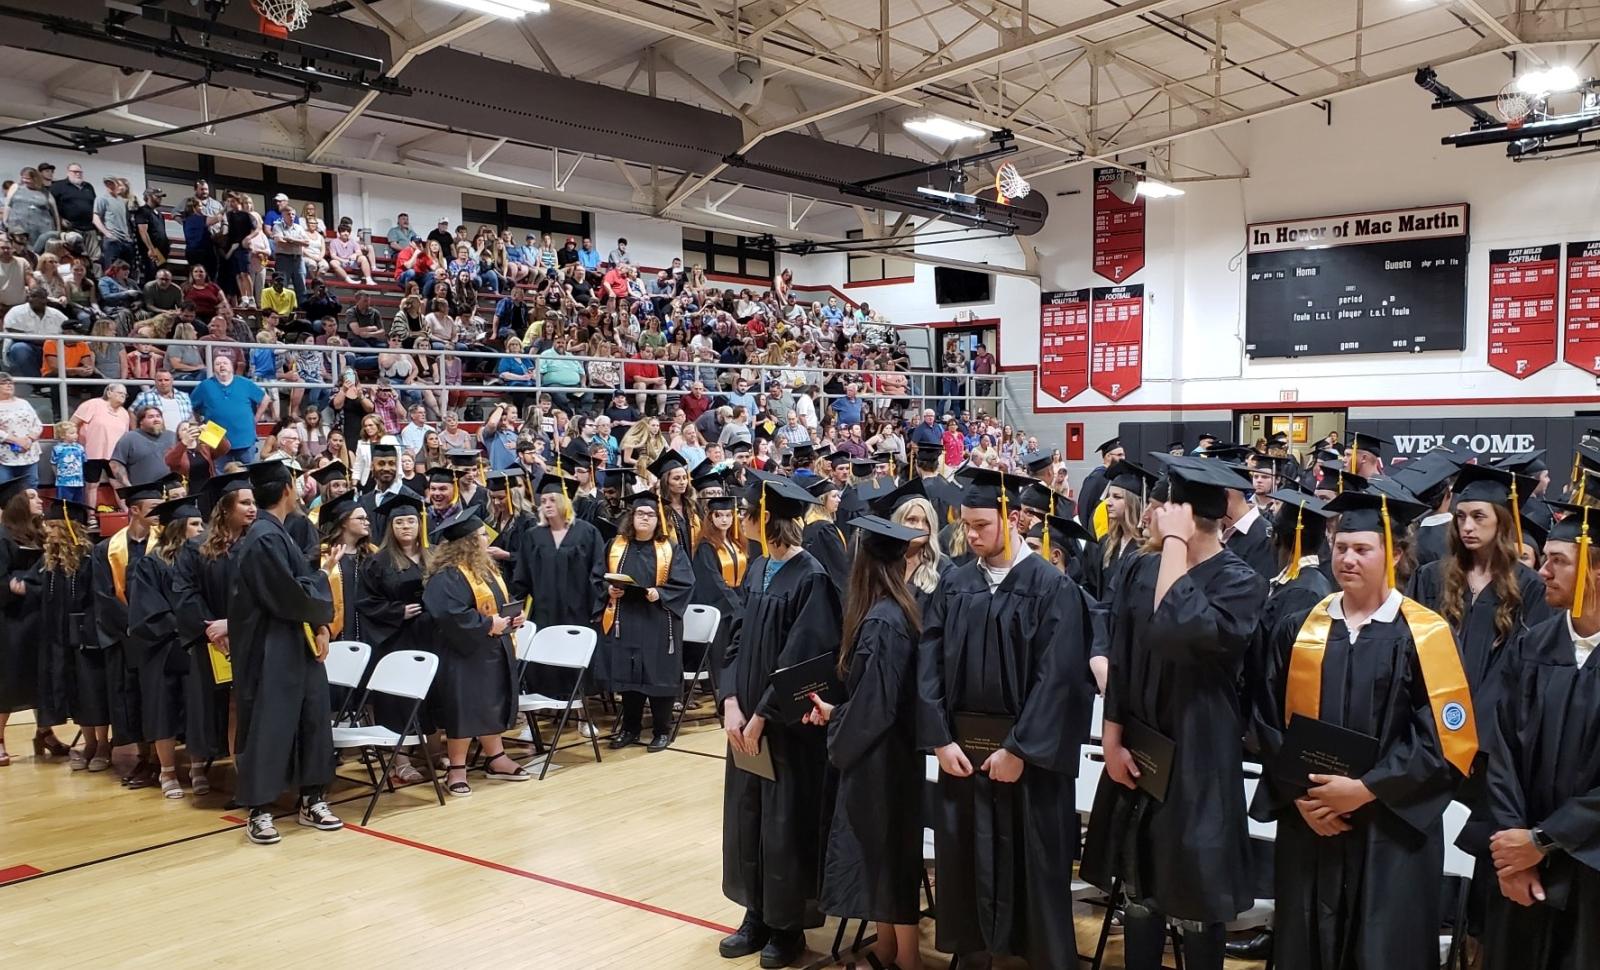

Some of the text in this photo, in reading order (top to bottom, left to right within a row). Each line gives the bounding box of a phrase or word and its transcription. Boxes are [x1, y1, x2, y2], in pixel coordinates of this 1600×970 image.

[1254, 211, 1460, 245] In Honor of Mac Martin
[1508, 254, 1542, 264] SOFTBALL
[1385, 260, 1412, 270] Guests
[1296, 267, 1316, 277] Home
[1338, 295, 1363, 305] period
[1293, 313, 1311, 321] fouls
[1338, 309, 1363, 319] player
[1391, 307, 1410, 316] fouls
[1340, 342, 1359, 350] game
[1392, 339, 1407, 347] won
[1516, 359, 1528, 373] F
